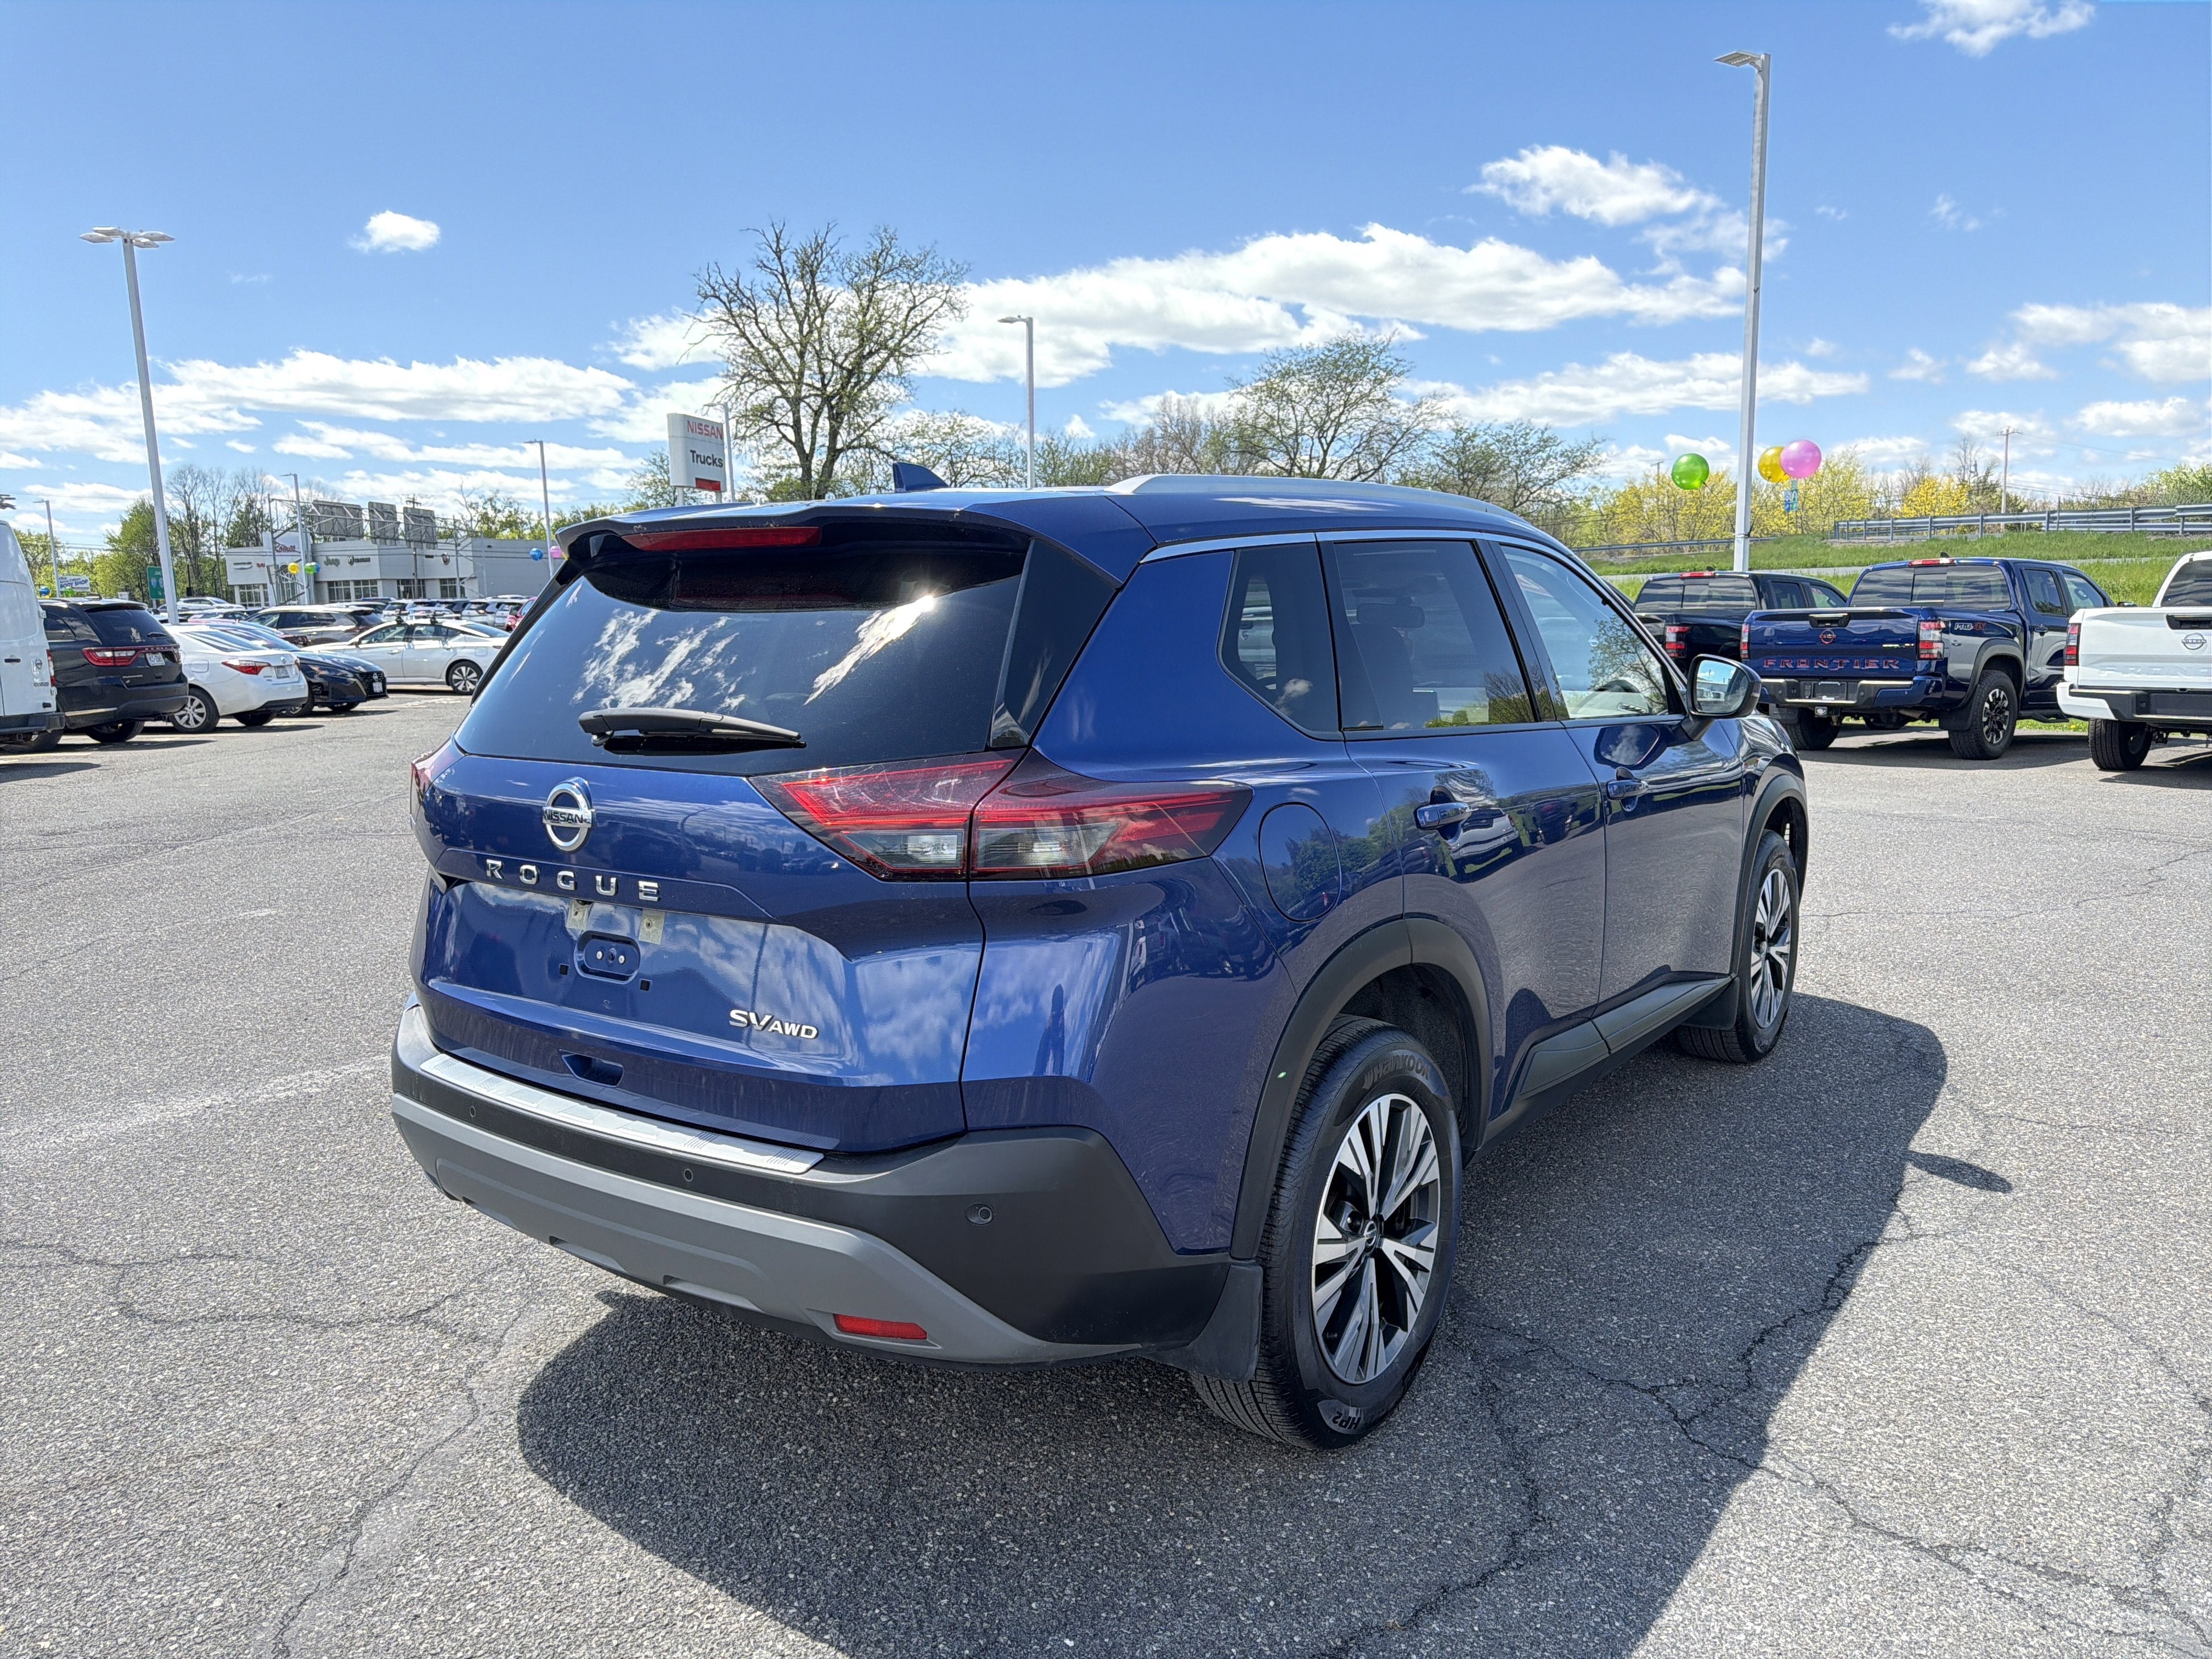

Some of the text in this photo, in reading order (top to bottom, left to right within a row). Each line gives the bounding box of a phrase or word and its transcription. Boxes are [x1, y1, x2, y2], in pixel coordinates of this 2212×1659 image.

[687, 420, 723, 440] NISSAN
[690, 449, 723, 468] Trucks
[1763, 659, 1900, 670] FRONTIER
[543, 809, 584, 823] NISSAN
[486, 859, 660, 902] ROGUE
[1331, 1410, 1361, 1430] HP2
